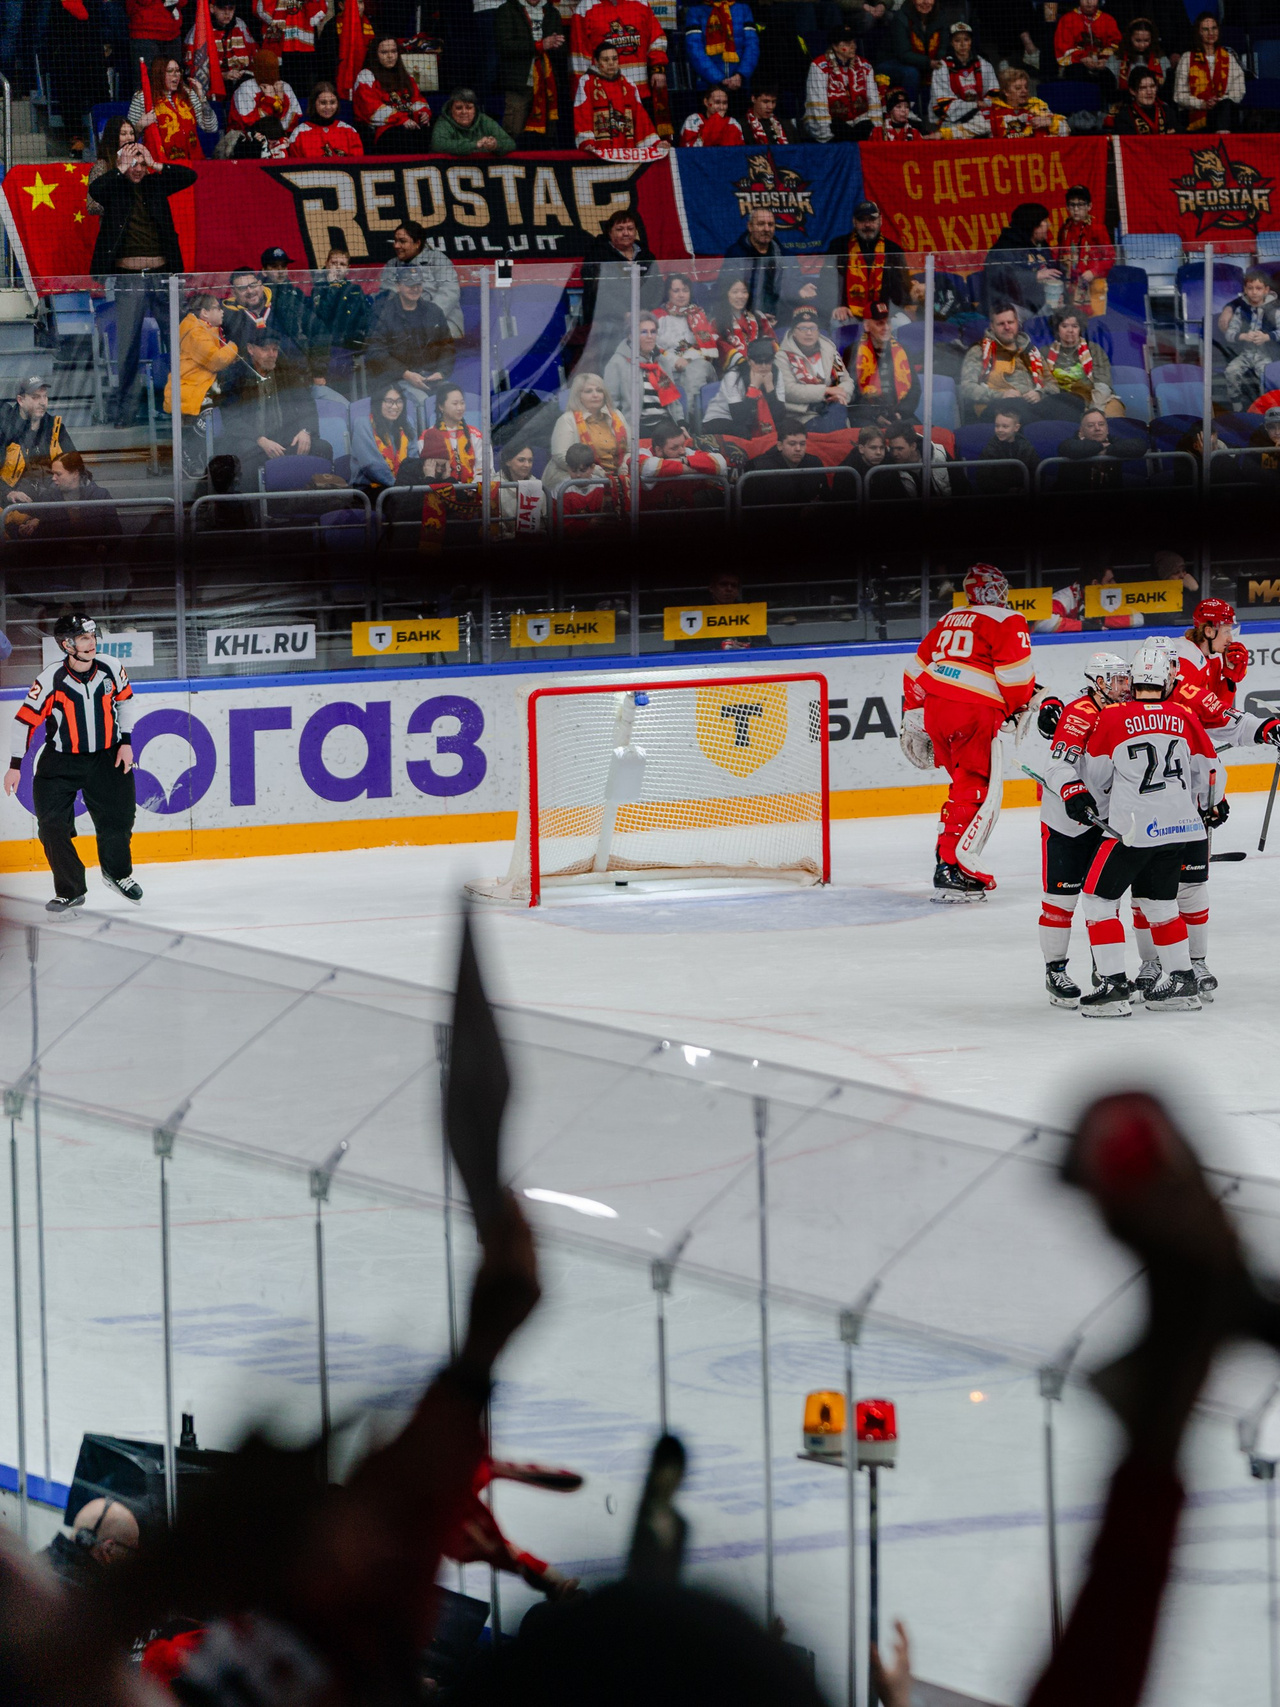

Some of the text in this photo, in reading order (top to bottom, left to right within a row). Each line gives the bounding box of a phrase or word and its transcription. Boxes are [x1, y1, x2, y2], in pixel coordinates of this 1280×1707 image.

[902, 151, 1070, 204] С ДЕТСТВА
[735, 191, 814, 216] REDSTAR
[1175, 189, 1271, 214] REDSTAR
[281, 162, 641, 270] REDSTAR
[894, 212, 939, 252] ЗА
[387, 235, 565, 252] UNLUN
[1006, 599, 1037, 611] АНК
[1125, 591, 1167, 604] БАНК
[554, 622, 598, 635] БАНК
[707, 614, 750, 627] БАНК
[943, 614, 977, 628] RYBAR
[214, 631, 309, 657] KHL.RU
[396, 630, 441, 643] БАНК
[1017, 632, 1031, 648] 2
[1144, 673, 1153, 682] 24
[809, 695, 905, 743] БА
[1125, 714, 1185, 734] SOLOVYEV
[1052, 741, 1081, 764] 86
[1127, 739, 1186, 794] 24
[1063, 784, 1087, 798] CCM
[961, 814, 982, 851] CCM
